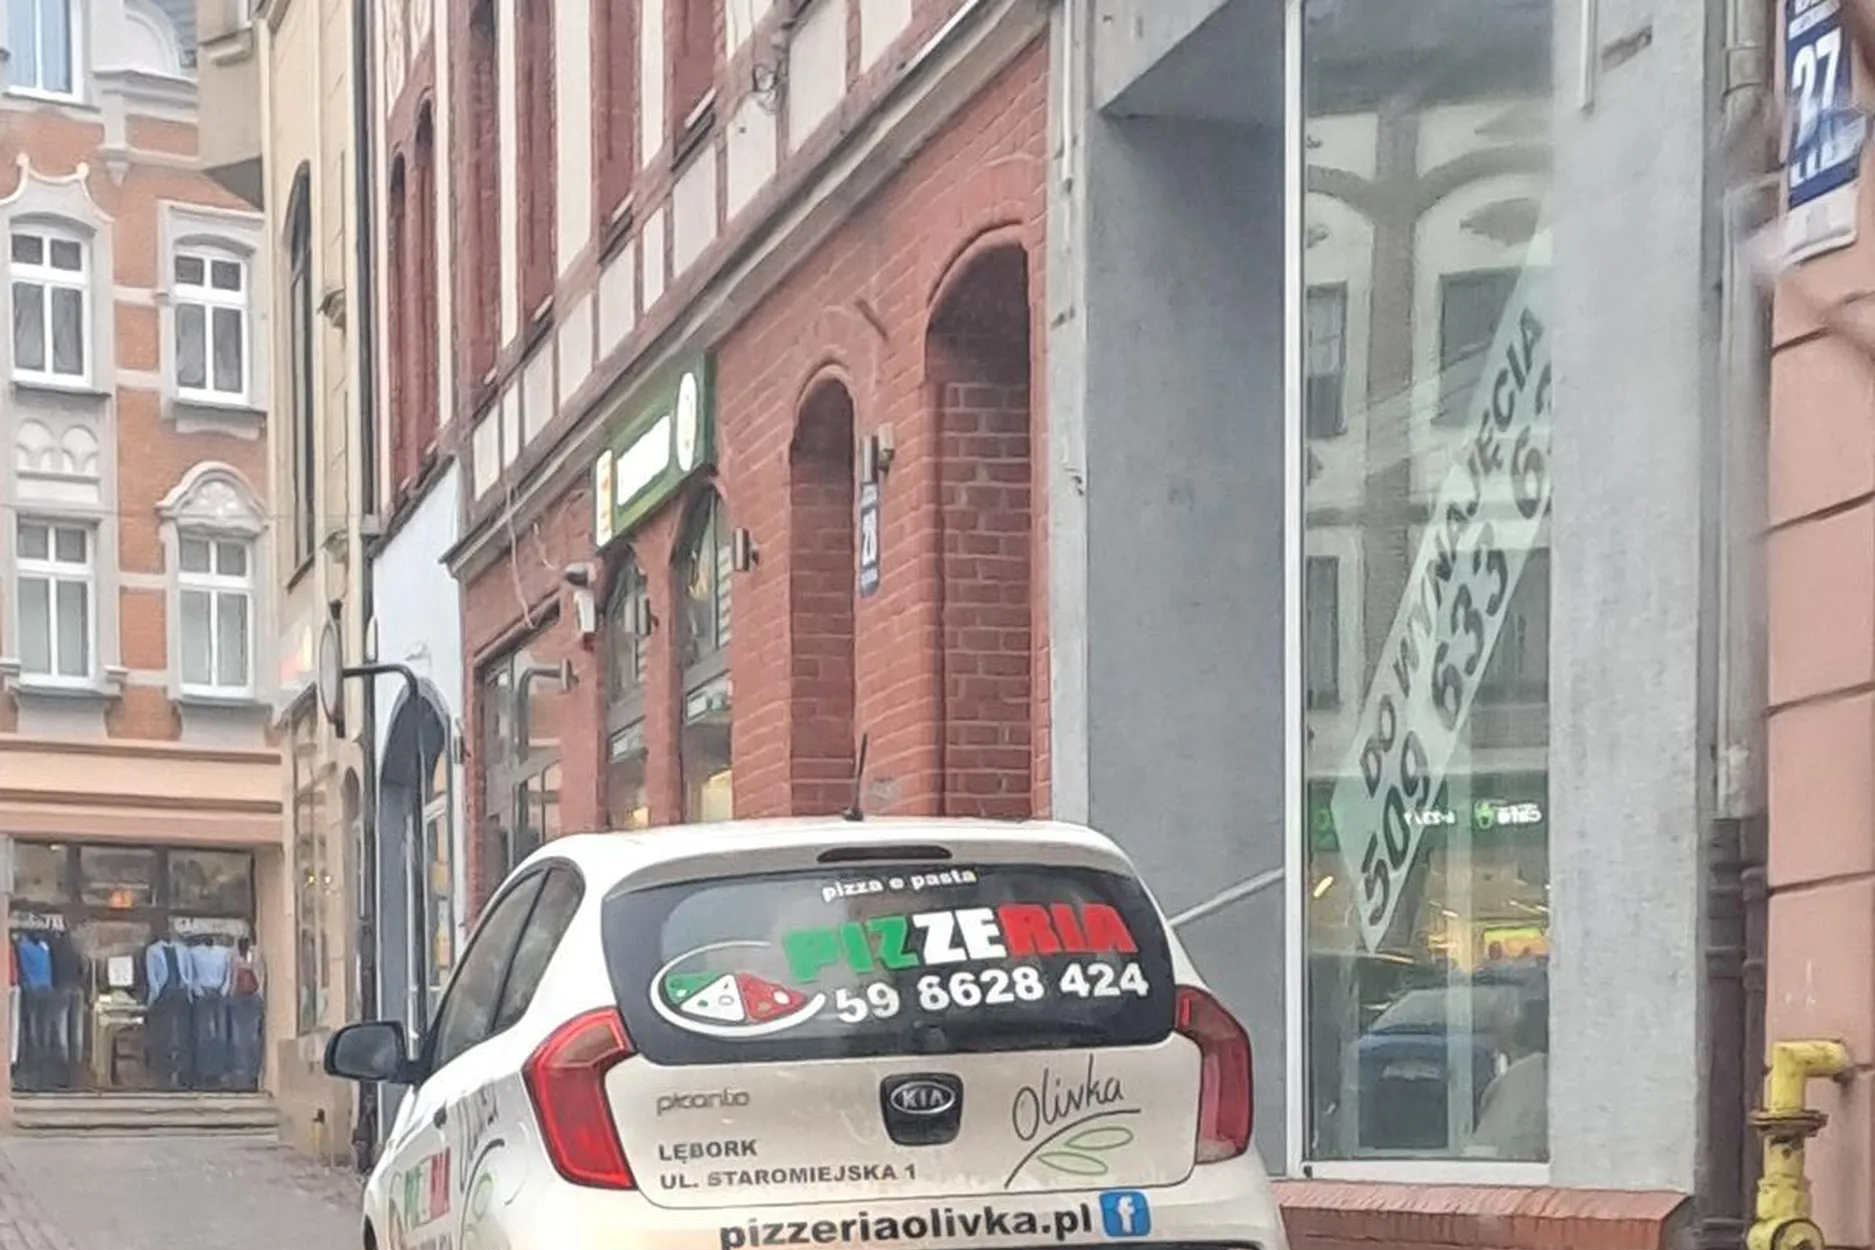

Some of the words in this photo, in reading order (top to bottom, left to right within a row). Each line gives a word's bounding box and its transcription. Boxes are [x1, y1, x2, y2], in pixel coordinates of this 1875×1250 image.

[1360, 694, 1397, 798] DO
[1361, 731, 1430, 927] 509
[1431, 522, 1508, 731] 633
[822, 879, 884, 903] pizza
[889, 877, 904, 890] e
[910, 869, 977, 890] pasta
[784, 904, 1137, 982] PIZZERIA
[835, 982, 899, 1023] 59
[916, 966, 1045, 1011] 8628
[1058, 963, 1149, 998] 424
[656, 1088, 751, 1116] picanto
[902, 1088, 944, 1109] KIA
[1012, 1052, 1124, 1141] Olivka
[658, 1139, 758, 1164] LĘBORK
[660, 1174, 699, 1191] UL.
[707, 1164, 898, 1187] STAROMIEJSKA
[905, 1163, 916, 1181] 1
